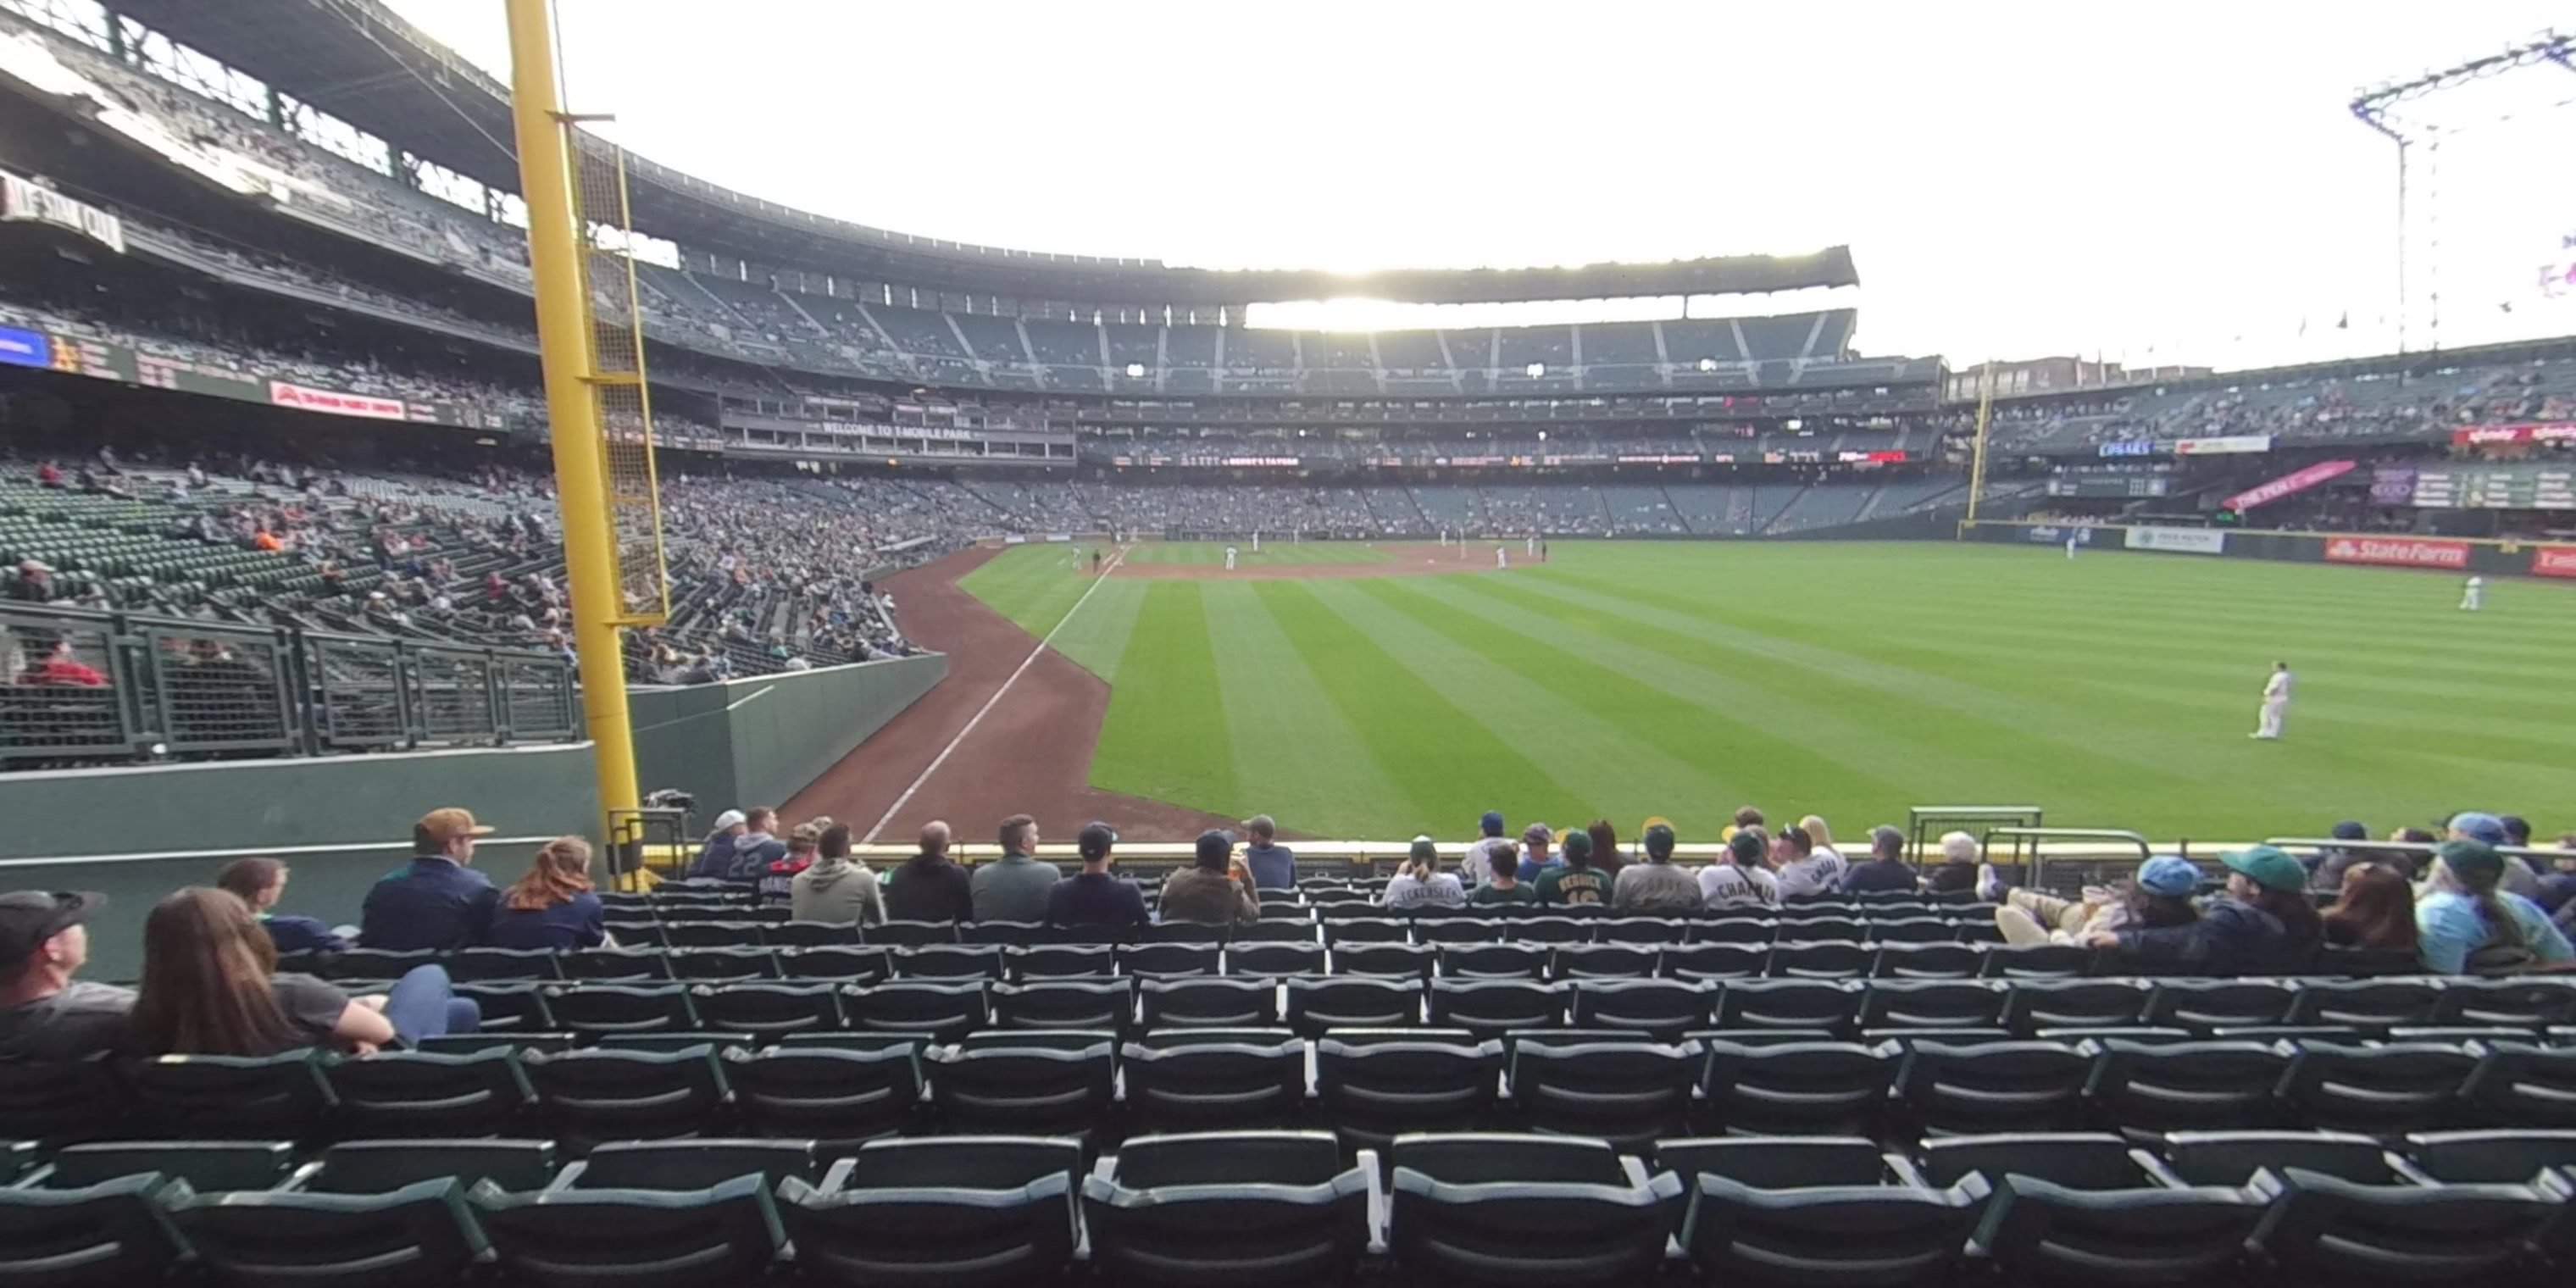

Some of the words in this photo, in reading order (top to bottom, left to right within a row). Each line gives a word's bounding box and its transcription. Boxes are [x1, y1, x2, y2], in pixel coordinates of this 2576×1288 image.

[822, 422, 874, 436] WELCOME
[877, 424, 892, 436] TO
[895, 426, 941, 440] T-MOBILE
[943, 428, 971, 440] PARK
[728, 852, 762, 876] 22
